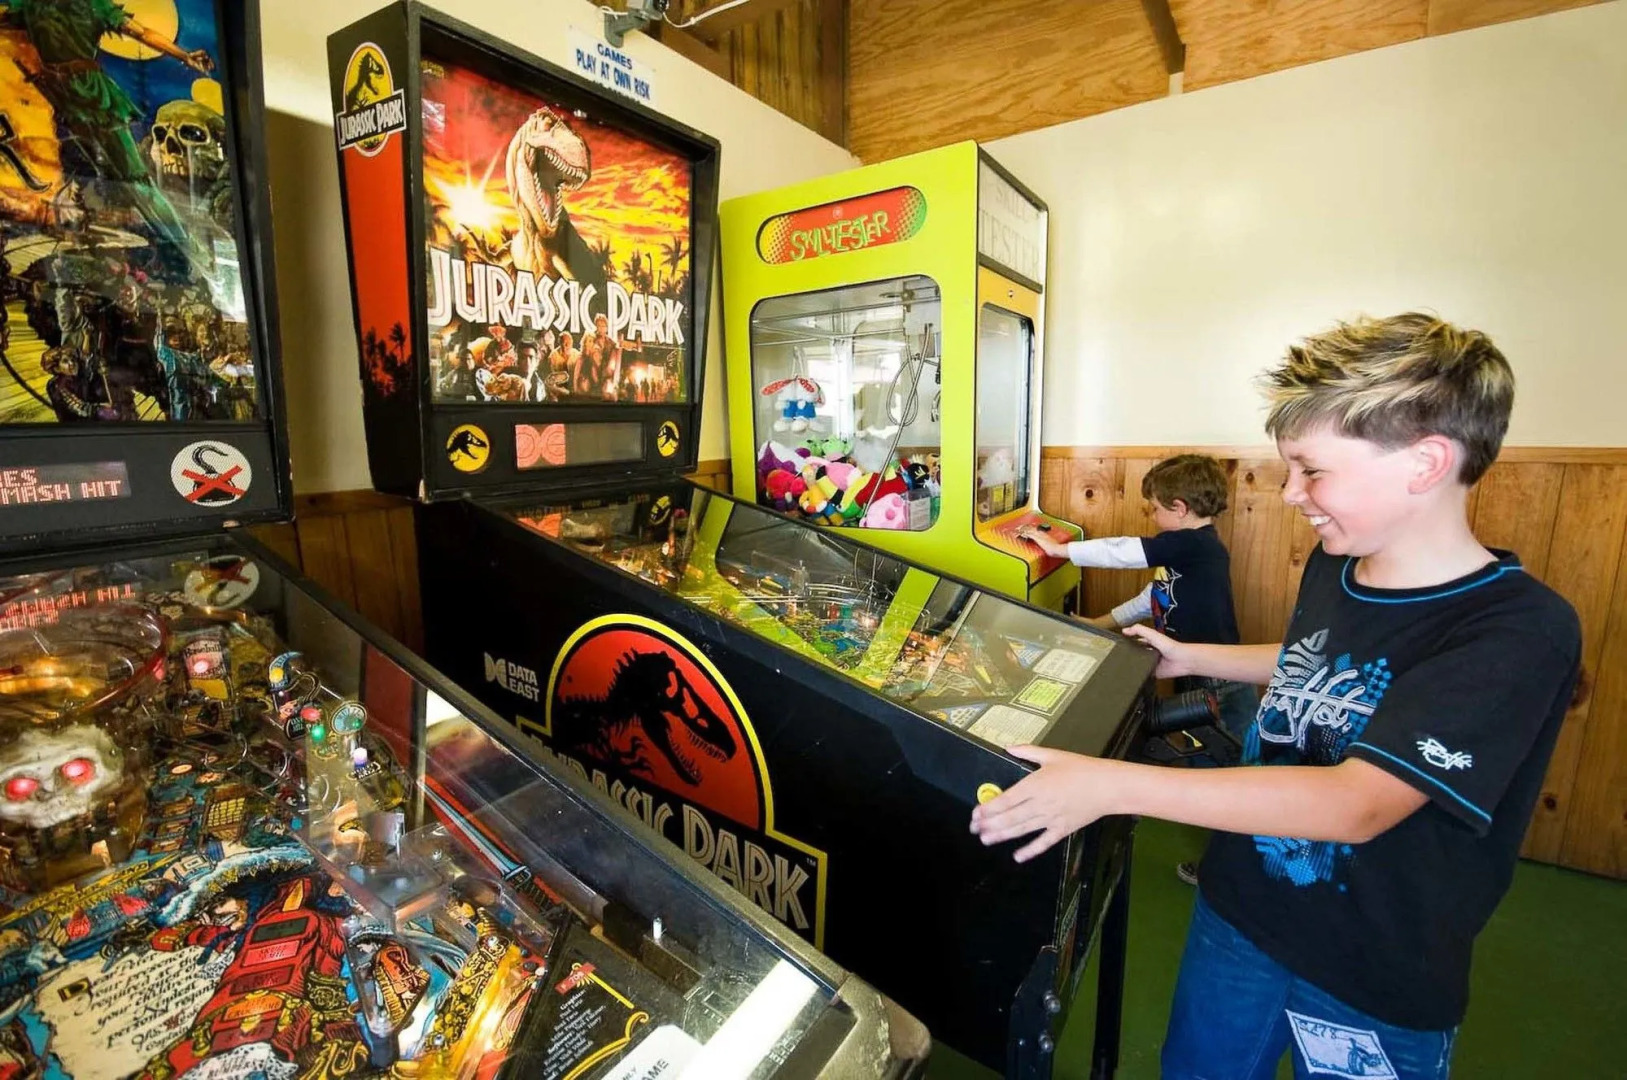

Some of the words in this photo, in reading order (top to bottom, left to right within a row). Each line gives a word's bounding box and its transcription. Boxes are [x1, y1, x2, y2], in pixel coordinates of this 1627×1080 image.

[576, 48, 596, 74] PLAY
[601, 61, 610, 80] AT
[614, 67, 632, 91] OWN
[634, 77, 651, 101] RISK
[597, 43, 632, 70] GAMES
[340, 108, 377, 145] JURASSIC
[376, 99, 403, 133] PARK
[427, 246, 598, 334] JURASSIC
[607, 280, 685, 346] PARK
[81, 480, 122, 499] HIT
[508, 660, 538, 686] DATA
[508, 678, 540, 703] EAST
[682, 803, 809, 929] PARK
